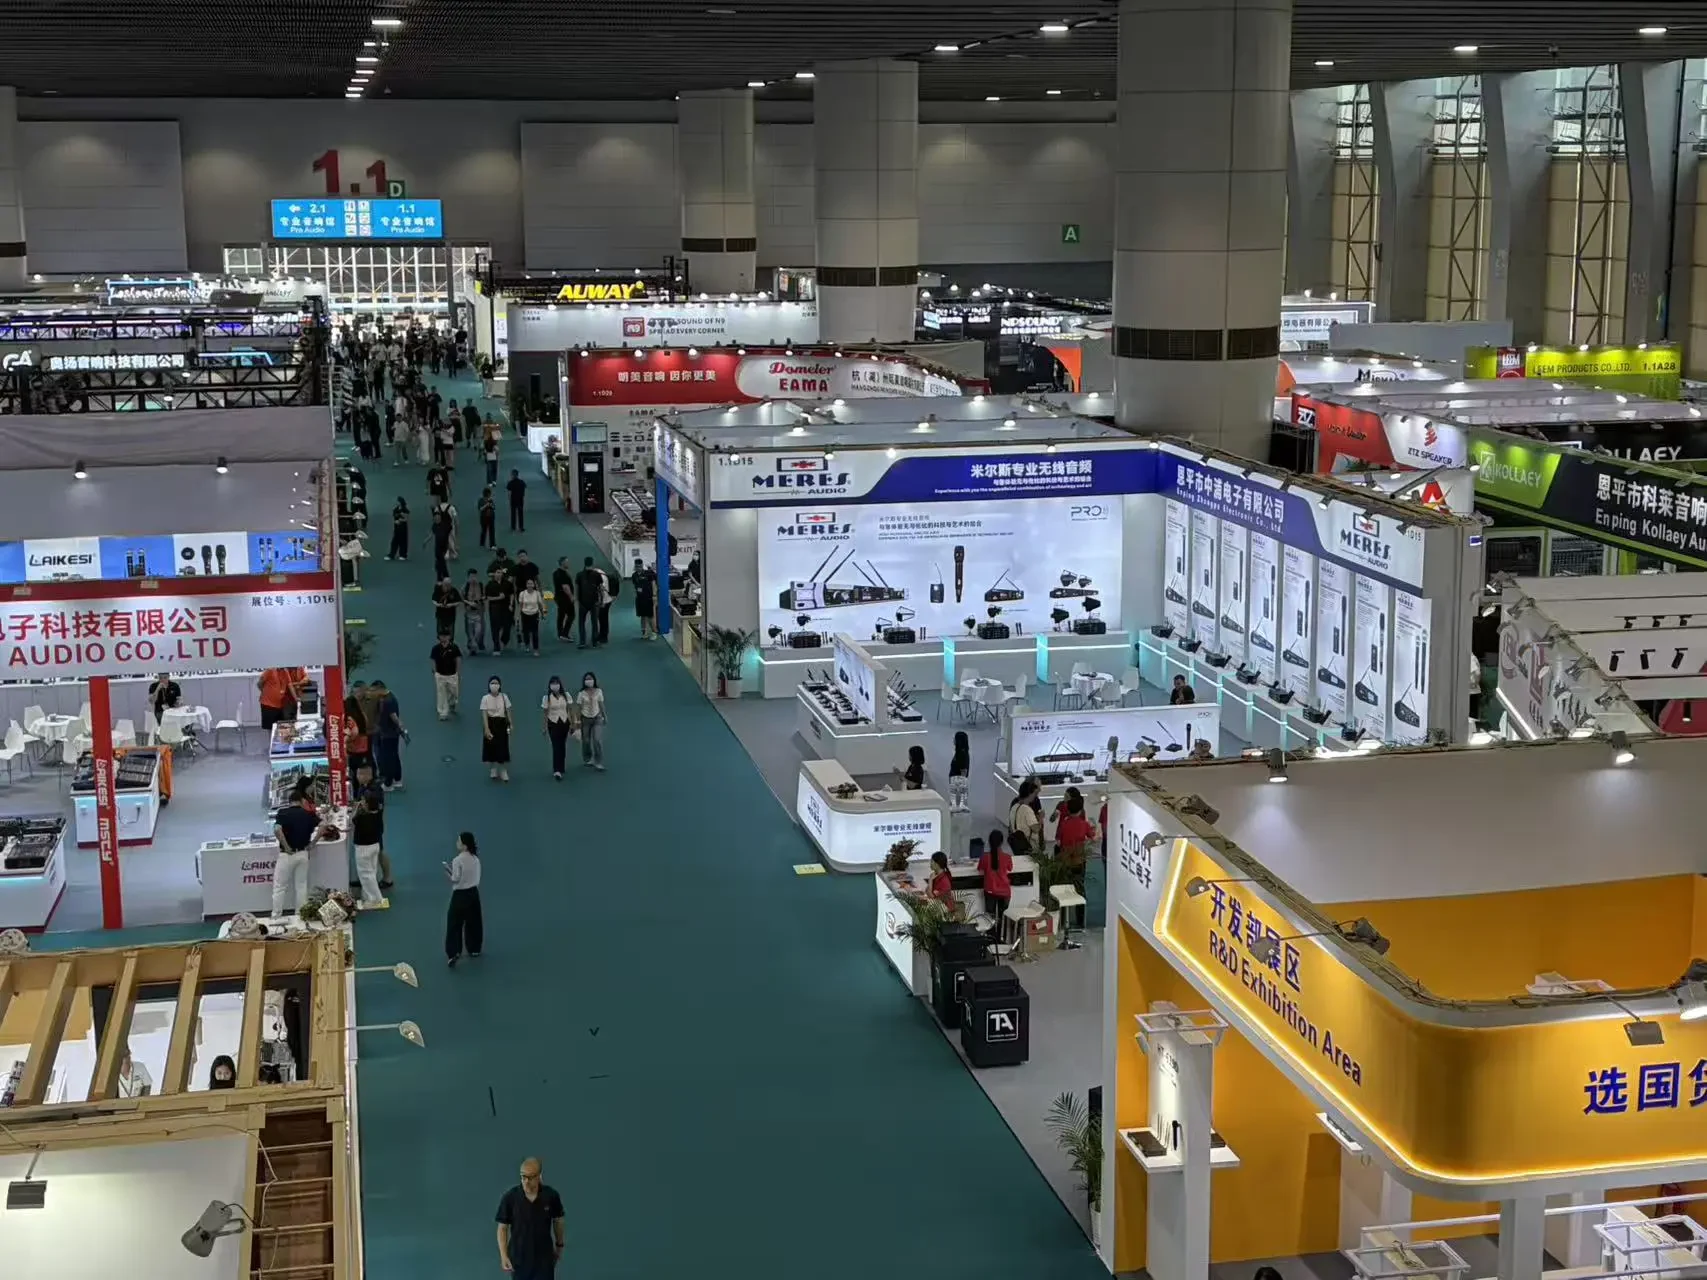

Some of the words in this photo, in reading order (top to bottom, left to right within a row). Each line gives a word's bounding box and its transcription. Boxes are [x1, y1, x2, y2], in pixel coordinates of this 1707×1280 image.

[313, 150, 386, 195] 1.1
[389, 182, 402, 197] D
[309, 204, 325, 213] 2.1
[399, 204, 415, 213] 1.1
[280, 217, 336, 226] 专业音响馆
[380, 217, 435, 226] 专业音响馆
[1064, 226, 1077, 240] A
[556, 283, 636, 299] AUWAY
[1557, 363, 1600, 373] PRODUCTS
[1643, 362, 1676, 371] 1.1A28
[779, 378, 829, 393] EAMA
[971, 460, 1092, 478] 米尔斯专业无线音频
[752, 473, 851, 488] MERES
[1495, 465, 1542, 488] KOLLAEY
[777, 524, 851, 536] MERES
[1642, 517, 1687, 550] Kollaey
[1340, 528, 1391, 560] MERES
[29, 553, 94, 566] LAIKESI
[1367, 557, 1389, 570] AUDIO
[297, 594, 335, 605] 1.1D16
[8, 642, 105, 668] AUDIO
[115, 637, 232, 662] CO.,LTD
[243, 874, 274, 884] MSC
[1209, 930, 1238, 976] R&D
[1242, 962, 1318, 1049] Exhibition
[1322, 1030, 1362, 1087] Area
